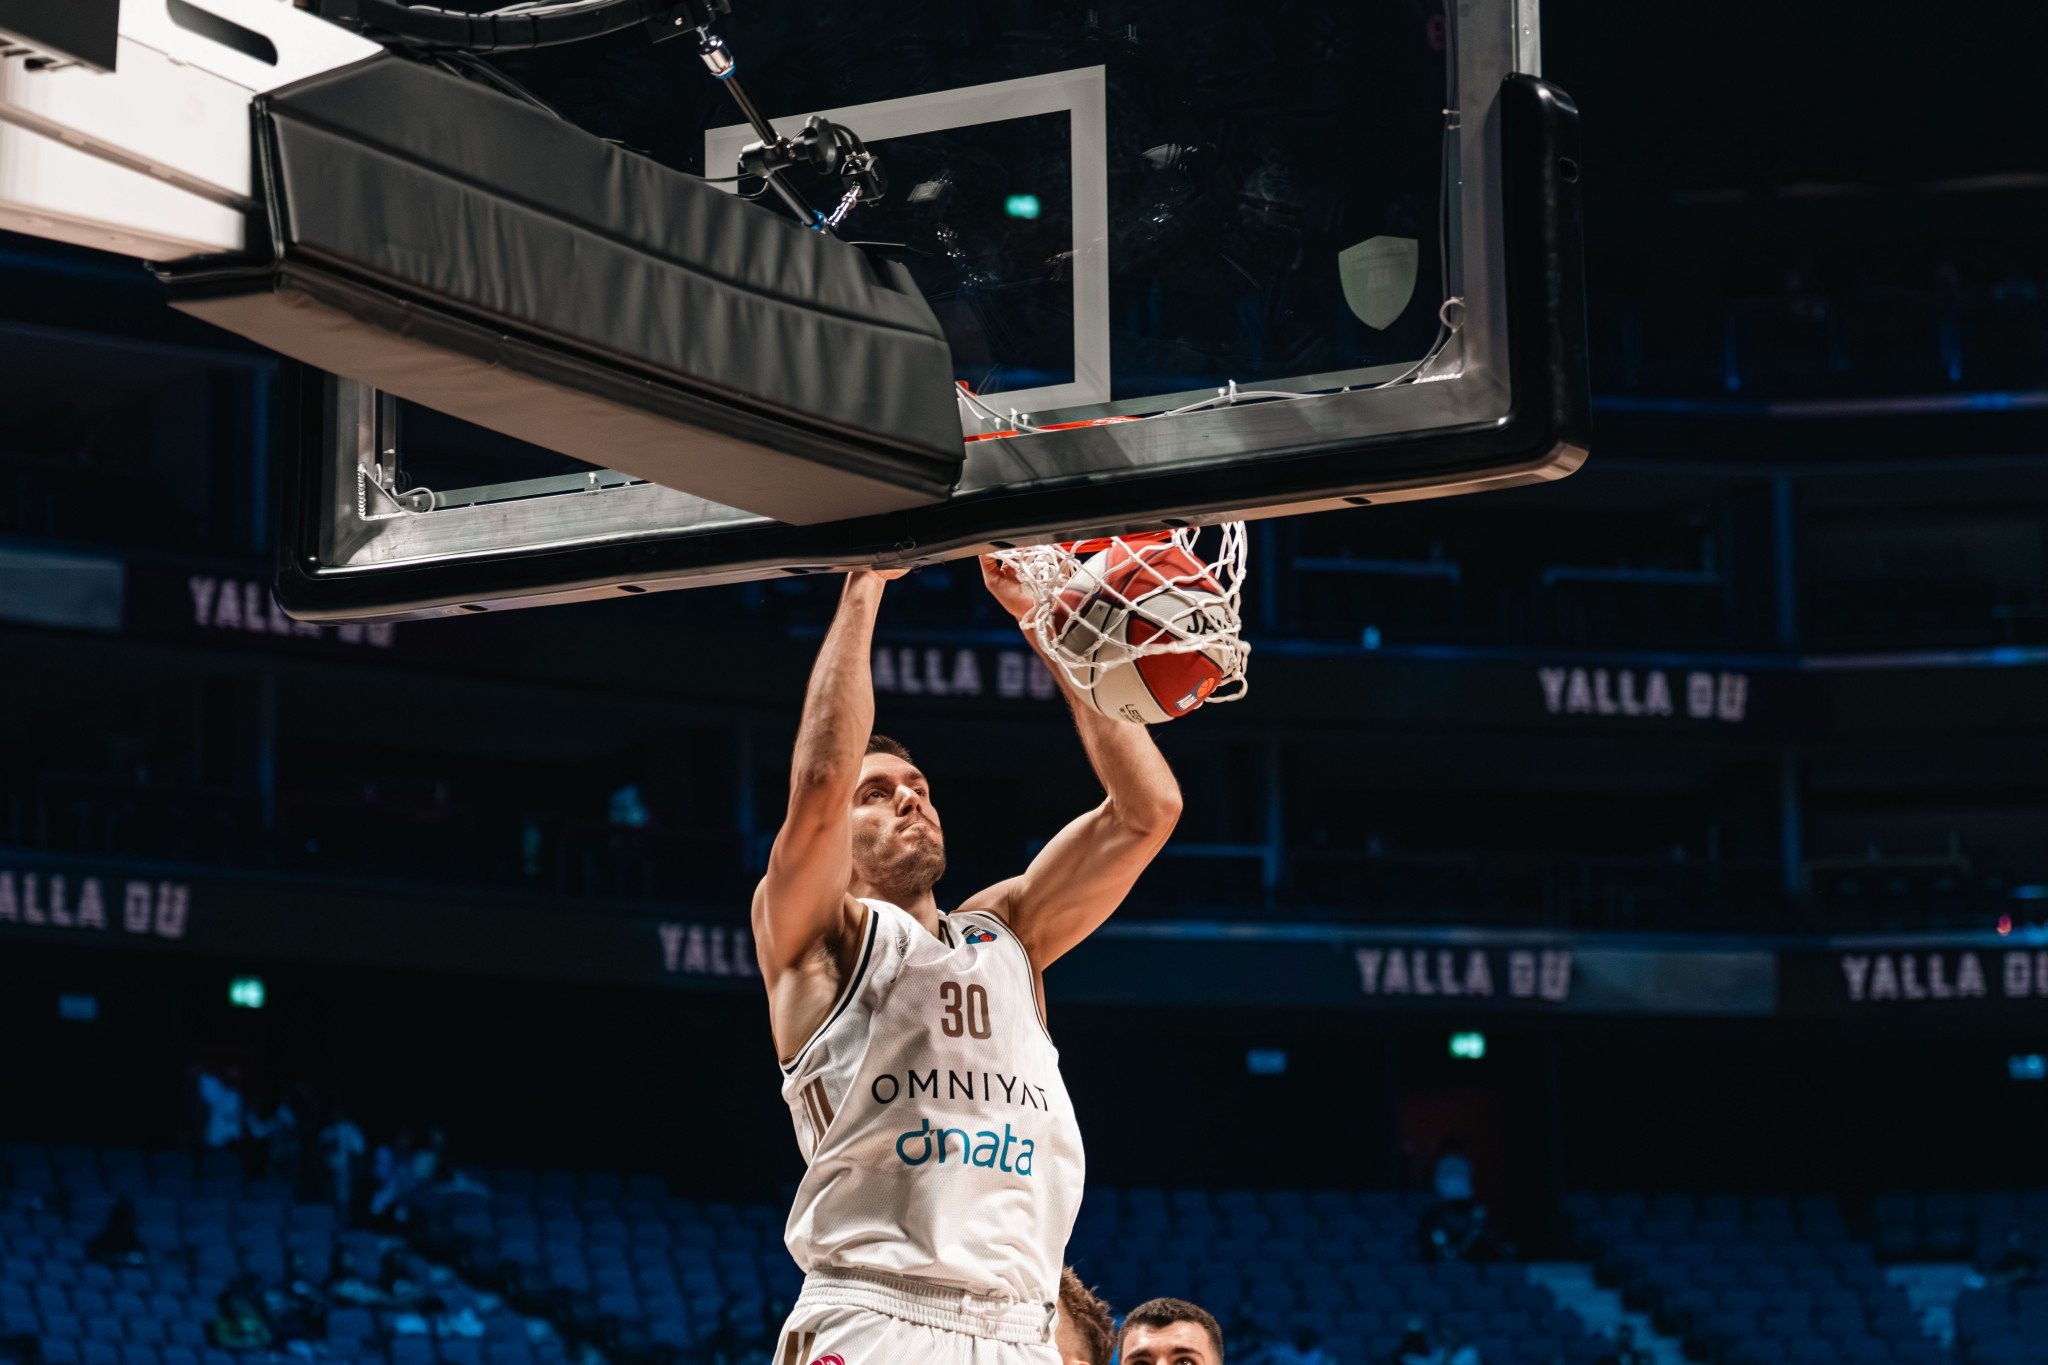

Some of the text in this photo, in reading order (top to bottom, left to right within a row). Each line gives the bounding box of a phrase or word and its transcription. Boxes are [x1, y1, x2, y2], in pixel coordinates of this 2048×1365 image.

[1539, 667, 1673, 717] YALLA
[1356, 949, 1494, 997] YALLA
[1842, 954, 1987, 1001] YALLA
[940, 981, 992, 1040] 30
[871, 1069, 1049, 1112] OMNIYAT
[896, 1118, 1035, 1176] dnata
